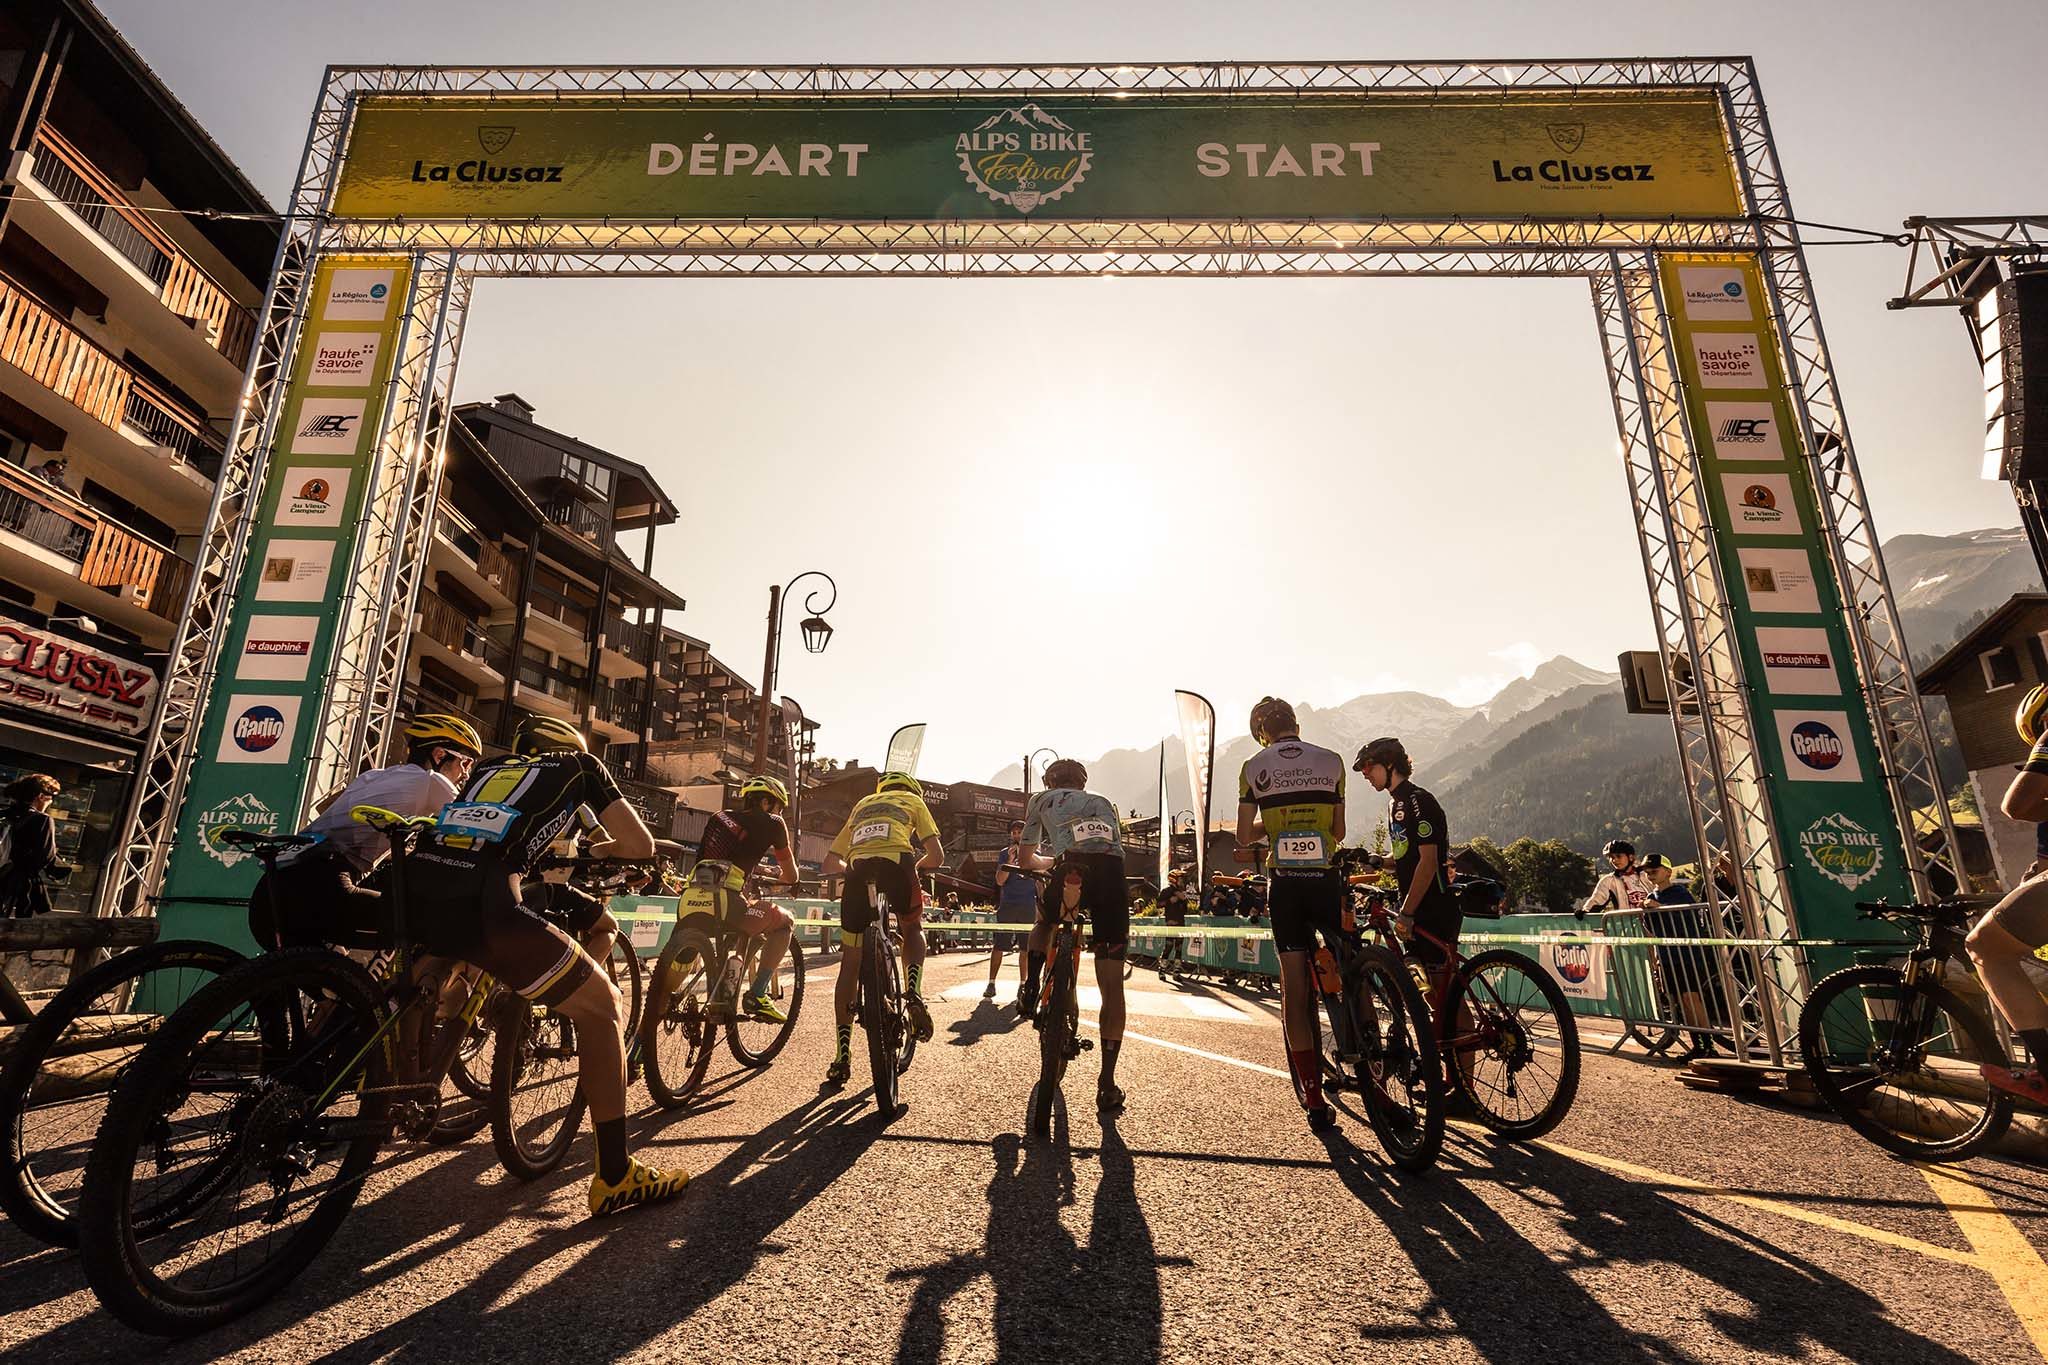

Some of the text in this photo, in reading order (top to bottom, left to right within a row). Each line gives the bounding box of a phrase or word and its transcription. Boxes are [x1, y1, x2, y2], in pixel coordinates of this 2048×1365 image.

[955, 132, 1094, 151] ALPS BIKE
[647, 132, 869, 177] DÉPART
[1196, 142, 1381, 177] START
[411, 159, 565, 182] La Clusaz
[977, 151, 1079, 184] Festival
[1492, 159, 1655, 182] La Clusaz
[342, 291, 368, 300] Région
[1696, 291, 1725, 299] Région
[319, 347, 360, 359] haute
[1699, 348, 1743, 360] haute
[317, 359, 364, 368] savoie
[1702, 360, 1751, 370] savoie
[247, 642, 257, 651] le
[258, 642, 302, 652] dauphiné
[1764, 654, 1775, 664] le
[1776, 654, 1821, 666] dauphiné
[0, 626, 150, 708] CLUSAZ
[235, 716, 285, 739] Radio
[1792, 732, 1844, 756] Radio
[1272, 767, 1313, 779] Gerbe
[1274, 776, 1335, 789] Savoyarde
[198, 810, 280, 825] ALPS BIKE
[460, 808, 500, 821] 250
[1077, 825, 1085, 833] 4
[1799, 831, 1883, 847] ALPS BIKE
[1283, 841, 1316, 852] 1 290
[1815, 846, 1874, 868] Festival
[634, 920, 640, 928] La
[1555, 944, 1590, 969] Radio
[1562, 985, 1584, 995] Annecy
